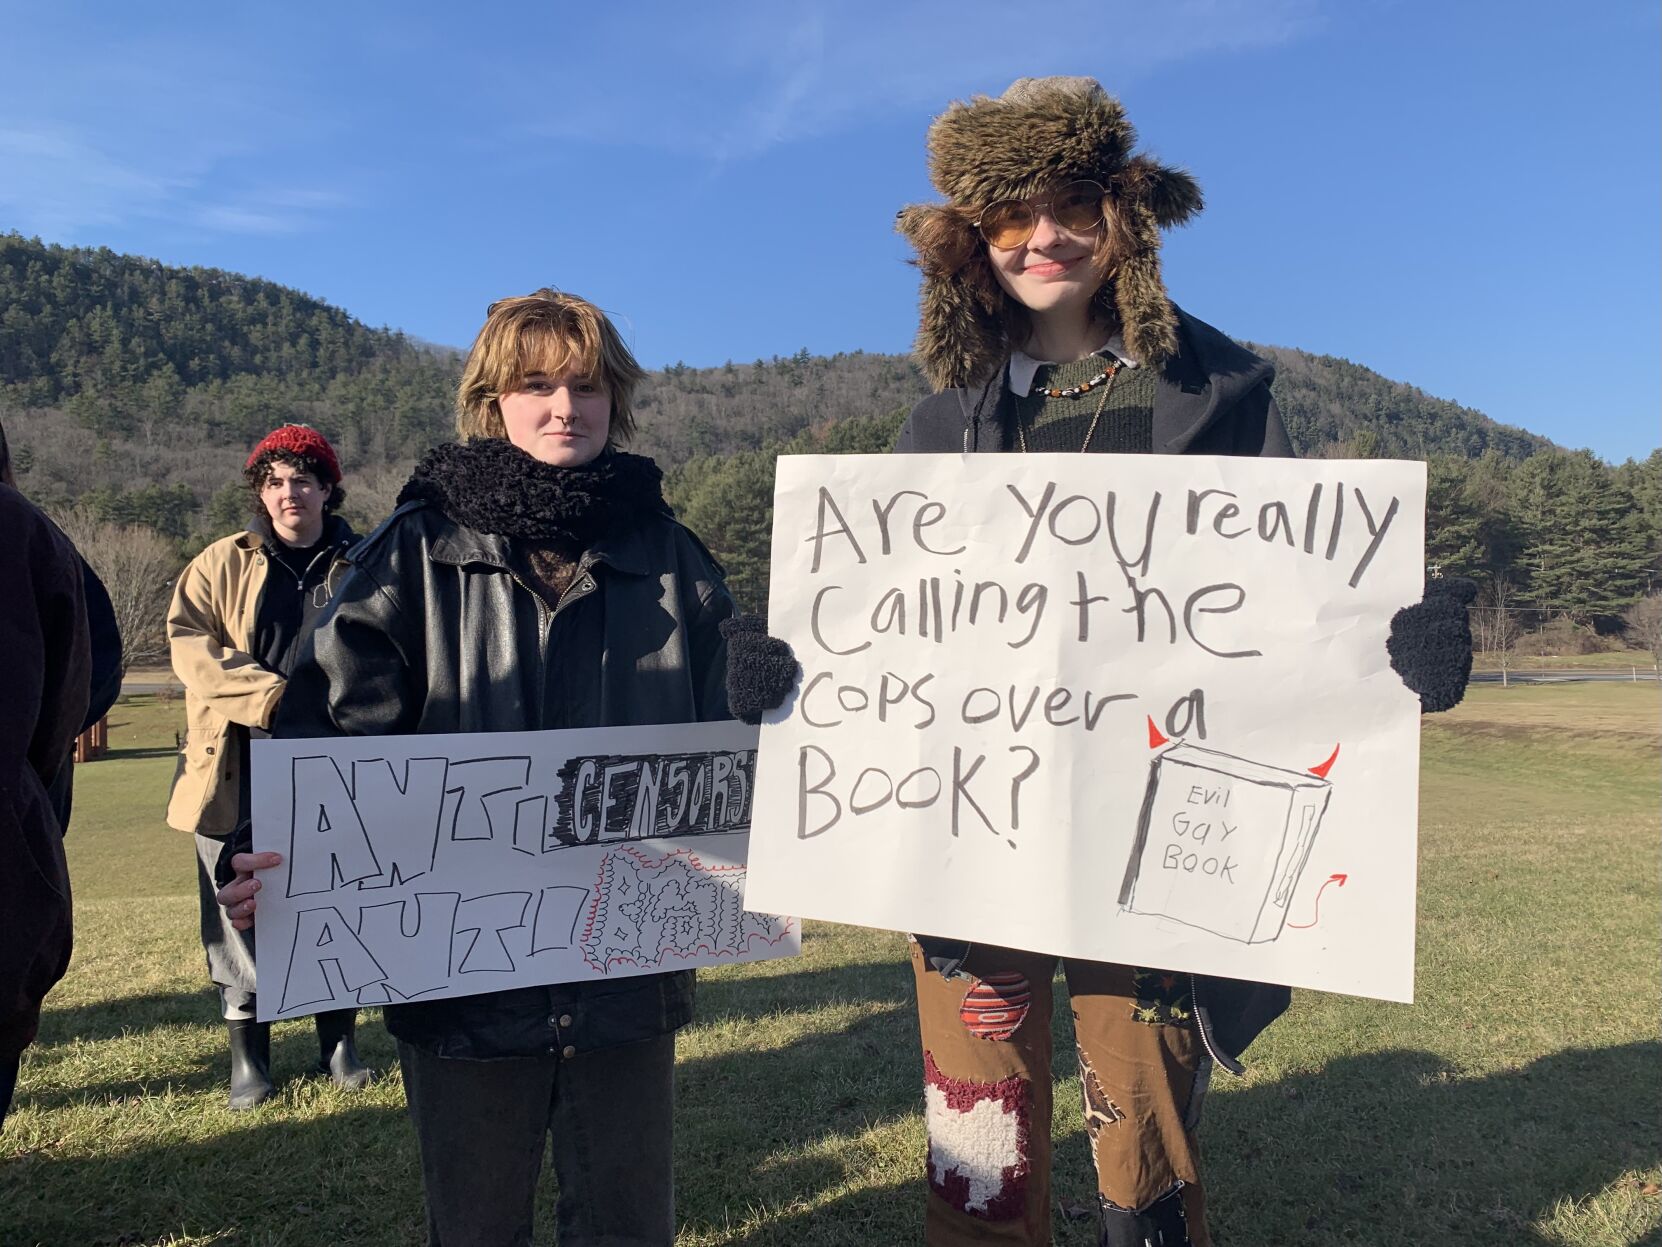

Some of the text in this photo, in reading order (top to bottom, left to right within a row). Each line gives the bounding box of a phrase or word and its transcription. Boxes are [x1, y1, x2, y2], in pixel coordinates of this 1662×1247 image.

[805, 485, 966, 575] Are
[1186, 481, 1400, 588] really
[1069, 560, 1263, 658] the
[961, 685, 1139, 733] over
[1165, 688, 1207, 740] a
[285, 750, 758, 900] ANTI CENSORS
